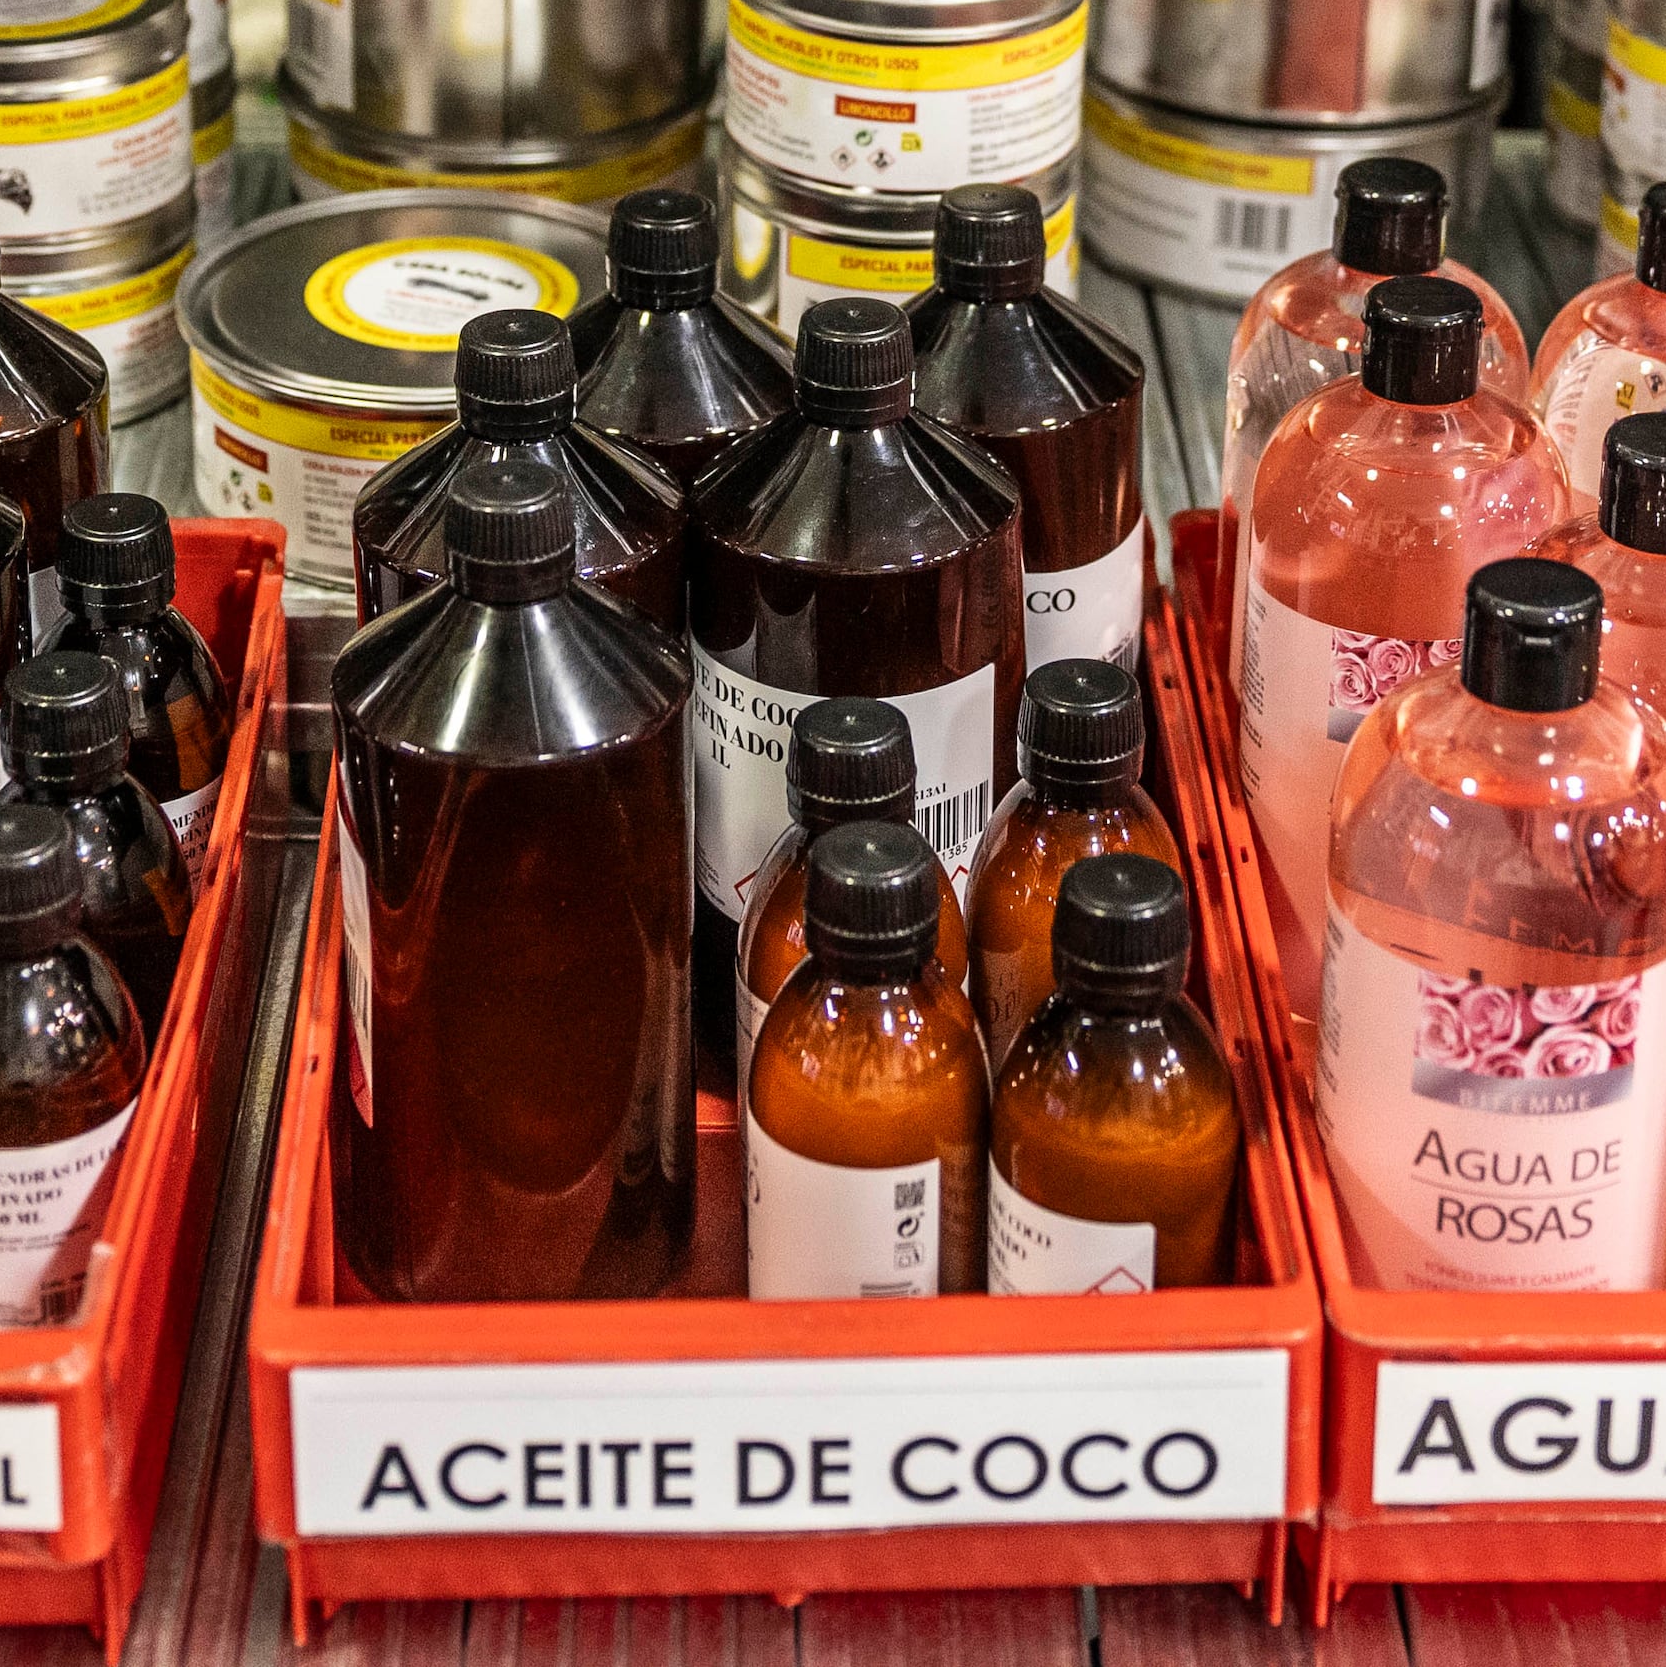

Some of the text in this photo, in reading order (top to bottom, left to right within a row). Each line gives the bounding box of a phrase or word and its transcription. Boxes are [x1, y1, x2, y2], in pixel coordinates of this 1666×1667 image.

[836, 50, 920, 72] OTROS USOS
[715, 676, 745, 714] DE
[694, 690, 784, 763] EFINADO
[710, 738, 731, 770] 1L
[1414, 1128, 1623, 1186] AGUA DE
[1436, 1196, 1594, 1244] ROSAS
[359, 1430, 1221, 1514] ACEITE DE COCO
